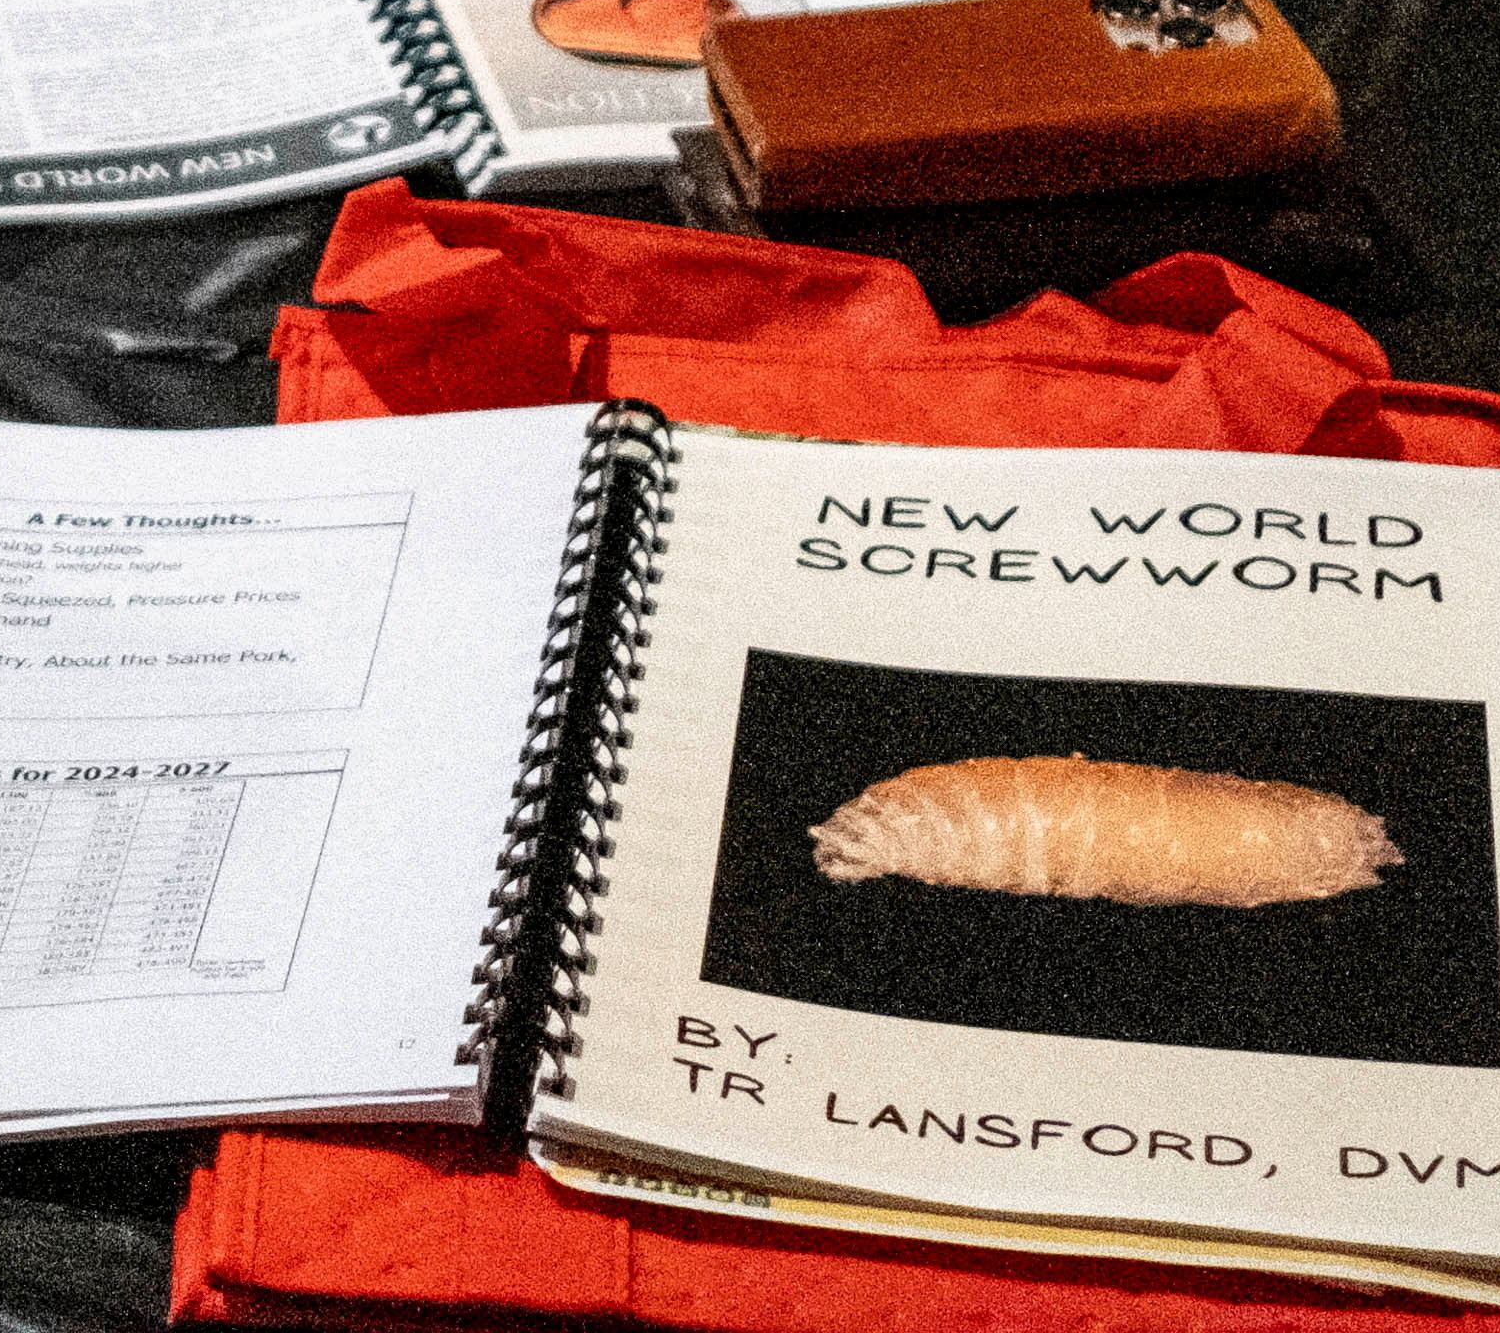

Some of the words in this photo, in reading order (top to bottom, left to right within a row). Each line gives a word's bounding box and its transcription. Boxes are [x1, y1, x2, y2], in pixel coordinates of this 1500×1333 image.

[180, 142, 278, 177] NEW
[13, 161, 172, 191] WORLD
[26, 512, 46, 527] A
[54, 513, 113, 528] Few
[815, 494, 1021, 535] NEW
[1089, 501, 1427, 551] WORLD
[49, 540, 144, 555] Supplies
[796, 536, 1446, 605] SCREWWORM
[0, 591, 117, 609] Squeezed,
[126, 593, 226, 607] Pressure
[232, 590, 302, 603] Prices
[42, 654, 113, 669] About
[120, 652, 158, 666] the
[164, 651, 233, 666] Same
[239, 649, 298, 664] Pork,
[11, 765, 58, 781] for
[63, 761, 232, 782] 2024-2027
[677, 1015, 792, 1065] BY:
[672, 1056, 765, 1106] TR
[824, 1091, 1282, 1181] LANSFORD,
